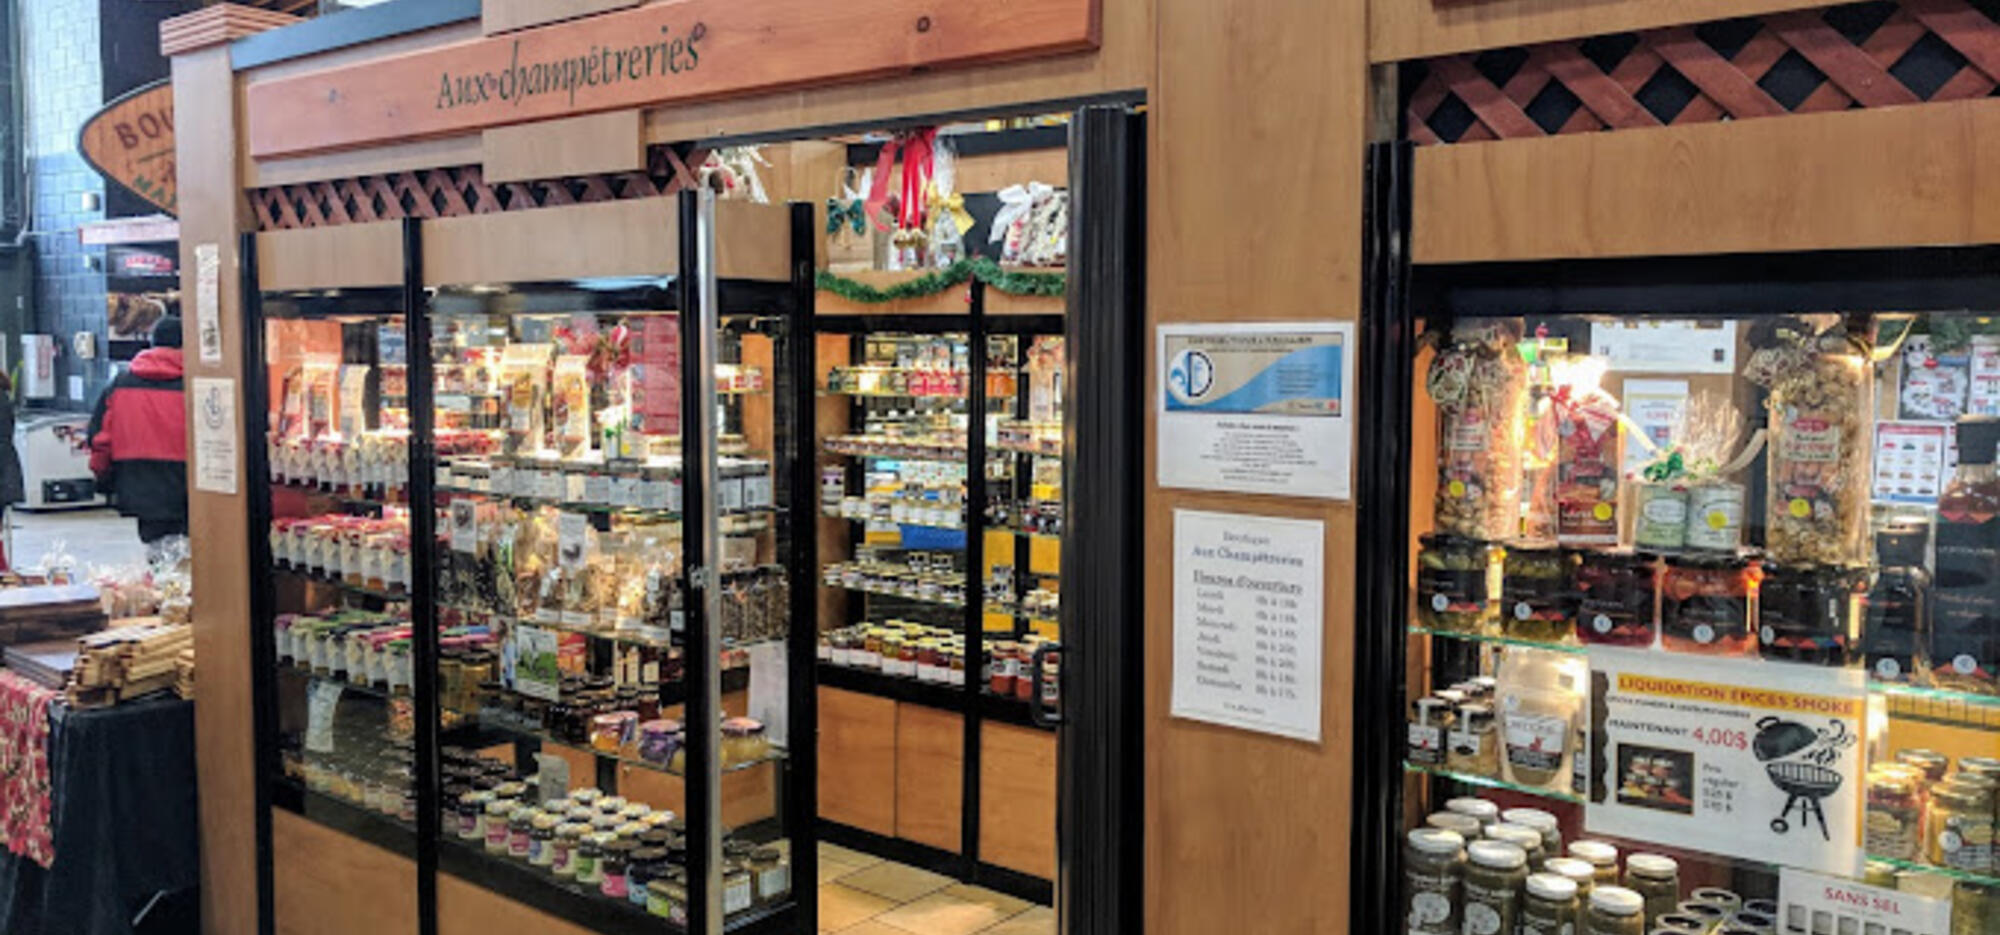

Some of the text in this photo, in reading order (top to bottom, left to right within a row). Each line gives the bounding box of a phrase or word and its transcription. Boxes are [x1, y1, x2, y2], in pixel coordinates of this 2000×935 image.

[437, 71, 490, 109] Aux
[114, 105, 174, 149] BOU
[1619, 677, 1726, 701] LIQUIDATION
[1793, 695, 1854, 715] SMOKE
[1608, 719, 1688, 736] MAINTENANT
[1824, 887, 1869, 908] SANS
[1873, 897, 1901, 915] SEL
